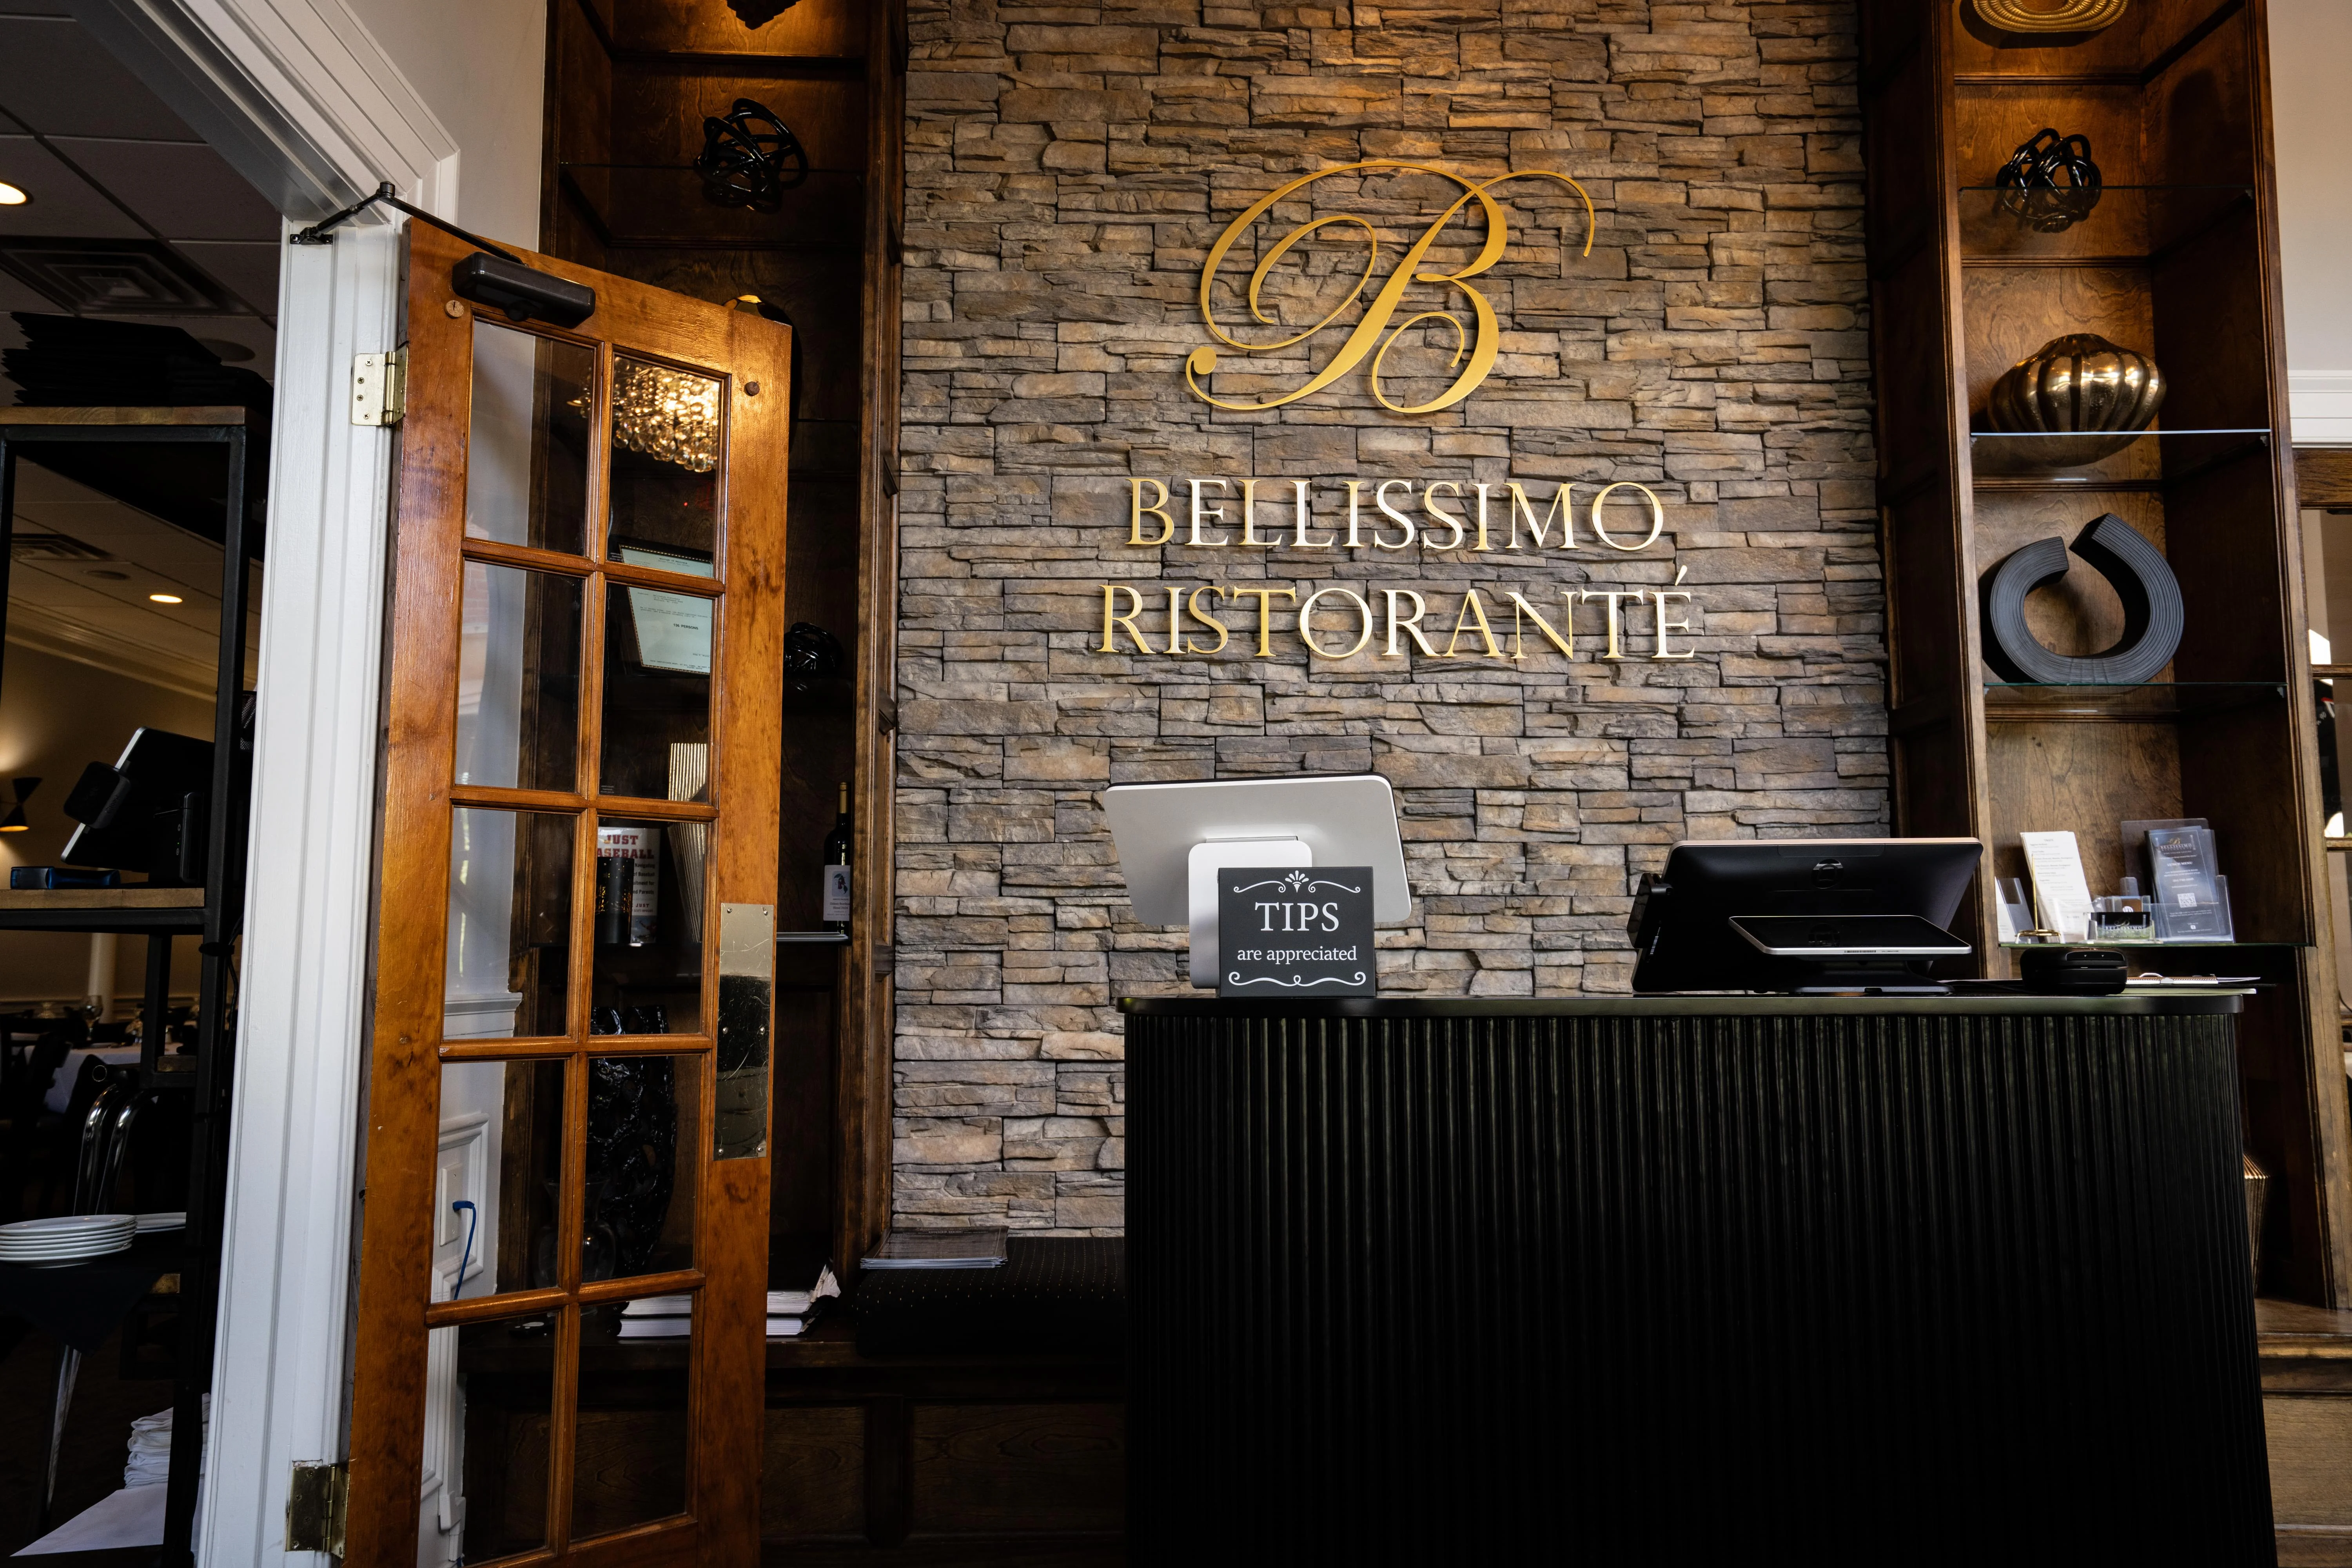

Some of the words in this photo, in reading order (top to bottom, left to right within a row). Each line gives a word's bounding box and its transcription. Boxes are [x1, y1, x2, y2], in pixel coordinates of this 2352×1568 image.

[1185, 161, 1595, 413] B
[1124, 478, 1664, 552] BELLISSIMO
[1096, 564, 1695, 660] RISTORANTÉ
[597, 848, 655, 859] ASEBALL
[604, 834, 639, 845] JUST
[1255, 902, 1339, 932] TIPS
[1237, 949, 1262, 961] are
[1267, 946, 1357, 964] appreciated
